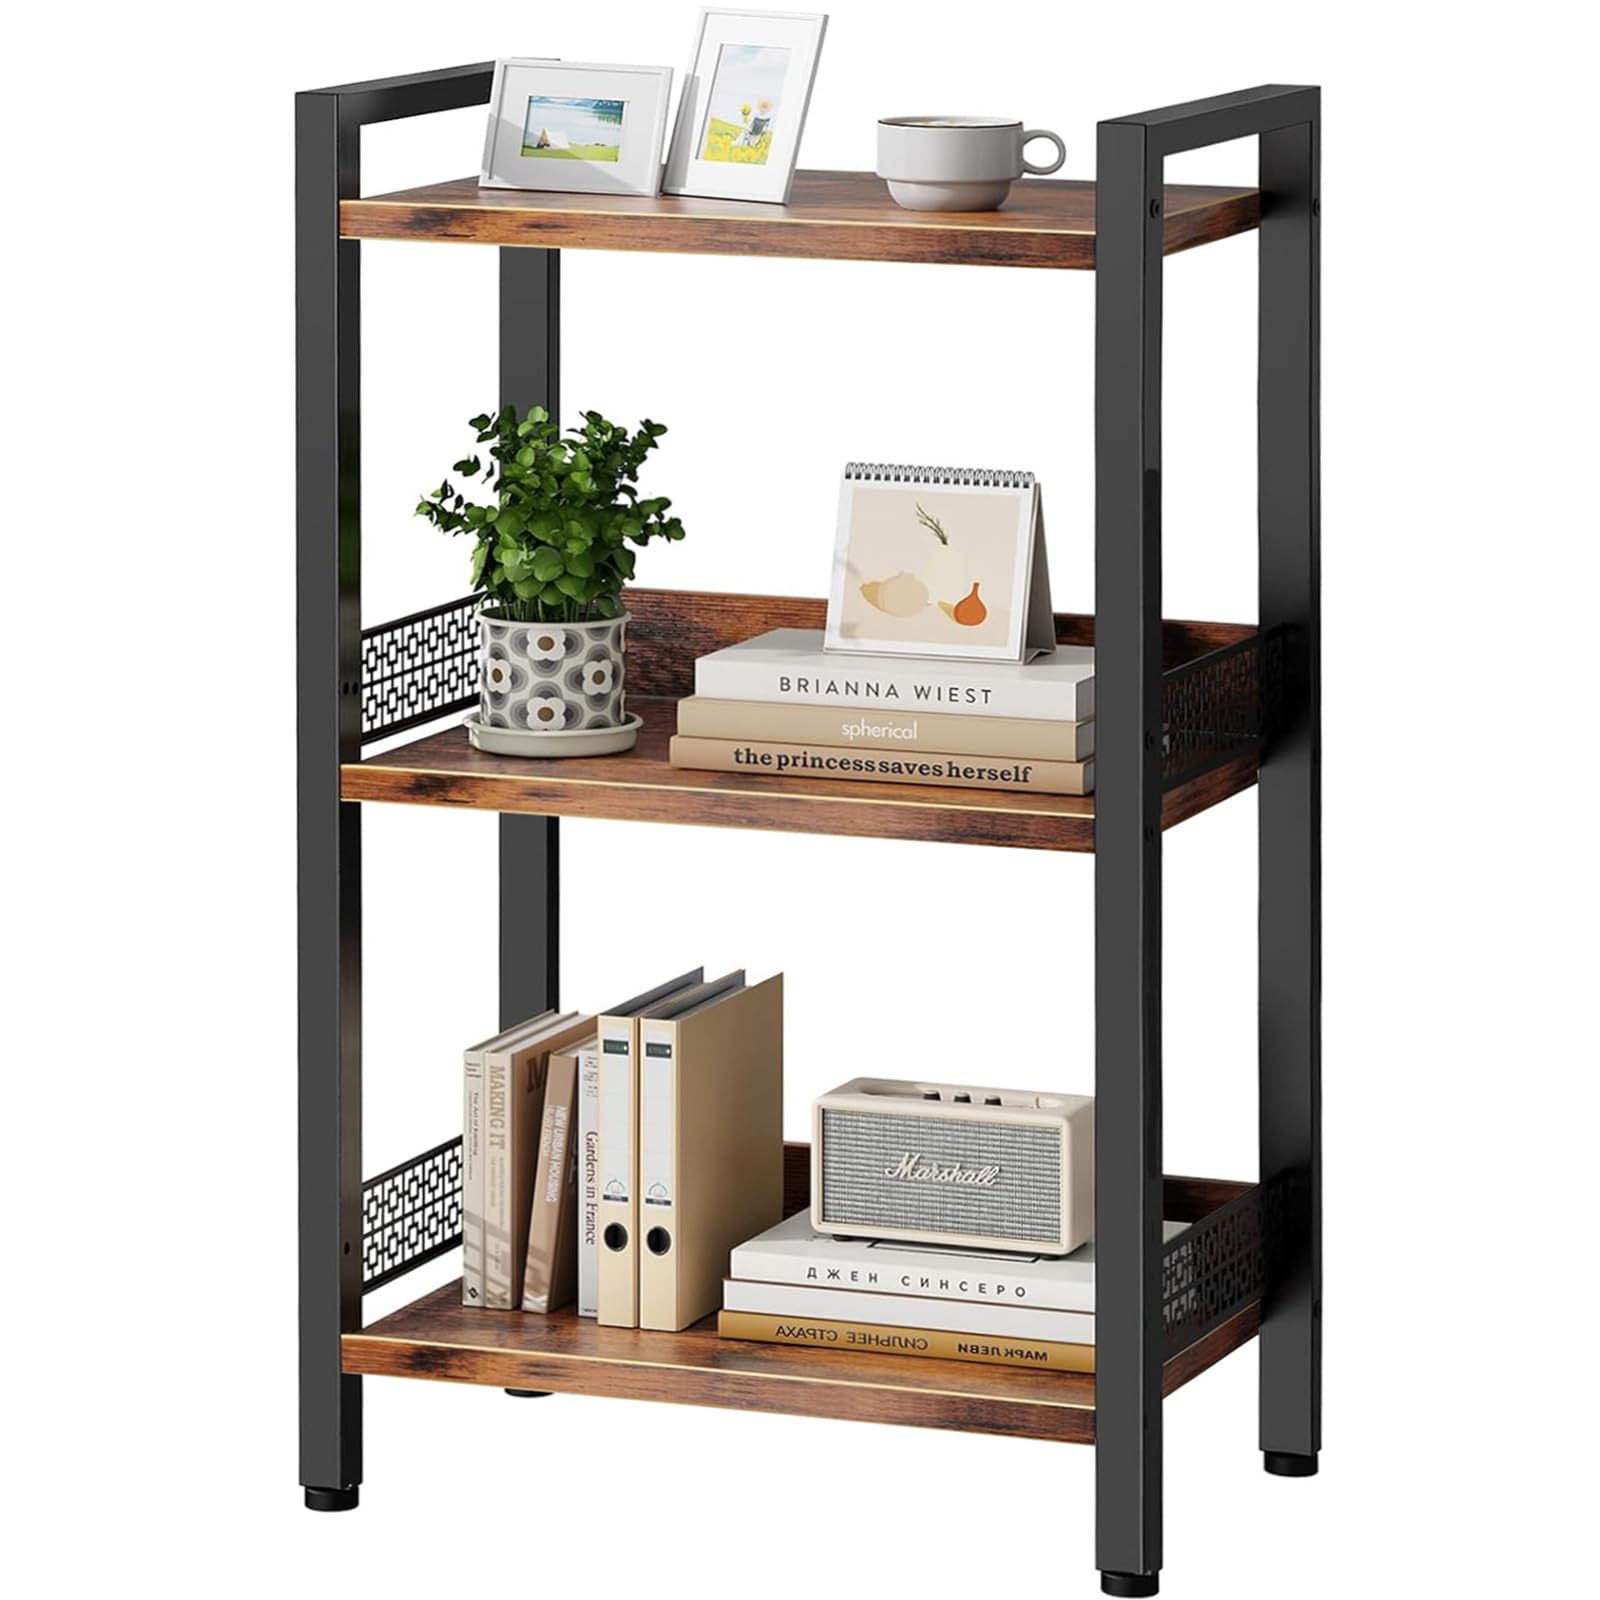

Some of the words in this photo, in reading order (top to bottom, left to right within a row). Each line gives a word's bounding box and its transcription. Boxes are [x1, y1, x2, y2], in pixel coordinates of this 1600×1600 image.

[780, 677, 900, 699] BRIANNA
[913, 685, 992, 705] WIEST
[841, 718, 918, 741] spherical
[733, 747, 772, 766] the
[776, 751, 875, 772] princess
[878, 760, 944, 777] saves
[948, 761, 1032, 783] herself
[489, 1065, 505, 1129] MAKING
[555, 1105, 568, 1128] NEW
[489, 1131, 505, 1150] IT
[585, 1131, 598, 1183] Gardens
[545, 1161, 560, 1202] HOUSING
[884, 1152, 1000, 1186] Marshall
[585, 1186, 597, 1199] in
[585, 1203, 598, 1245] France
[806, 1266, 878, 1284] ДЖЕН
[901, 1275, 1026, 1298] СИНСЕРО
